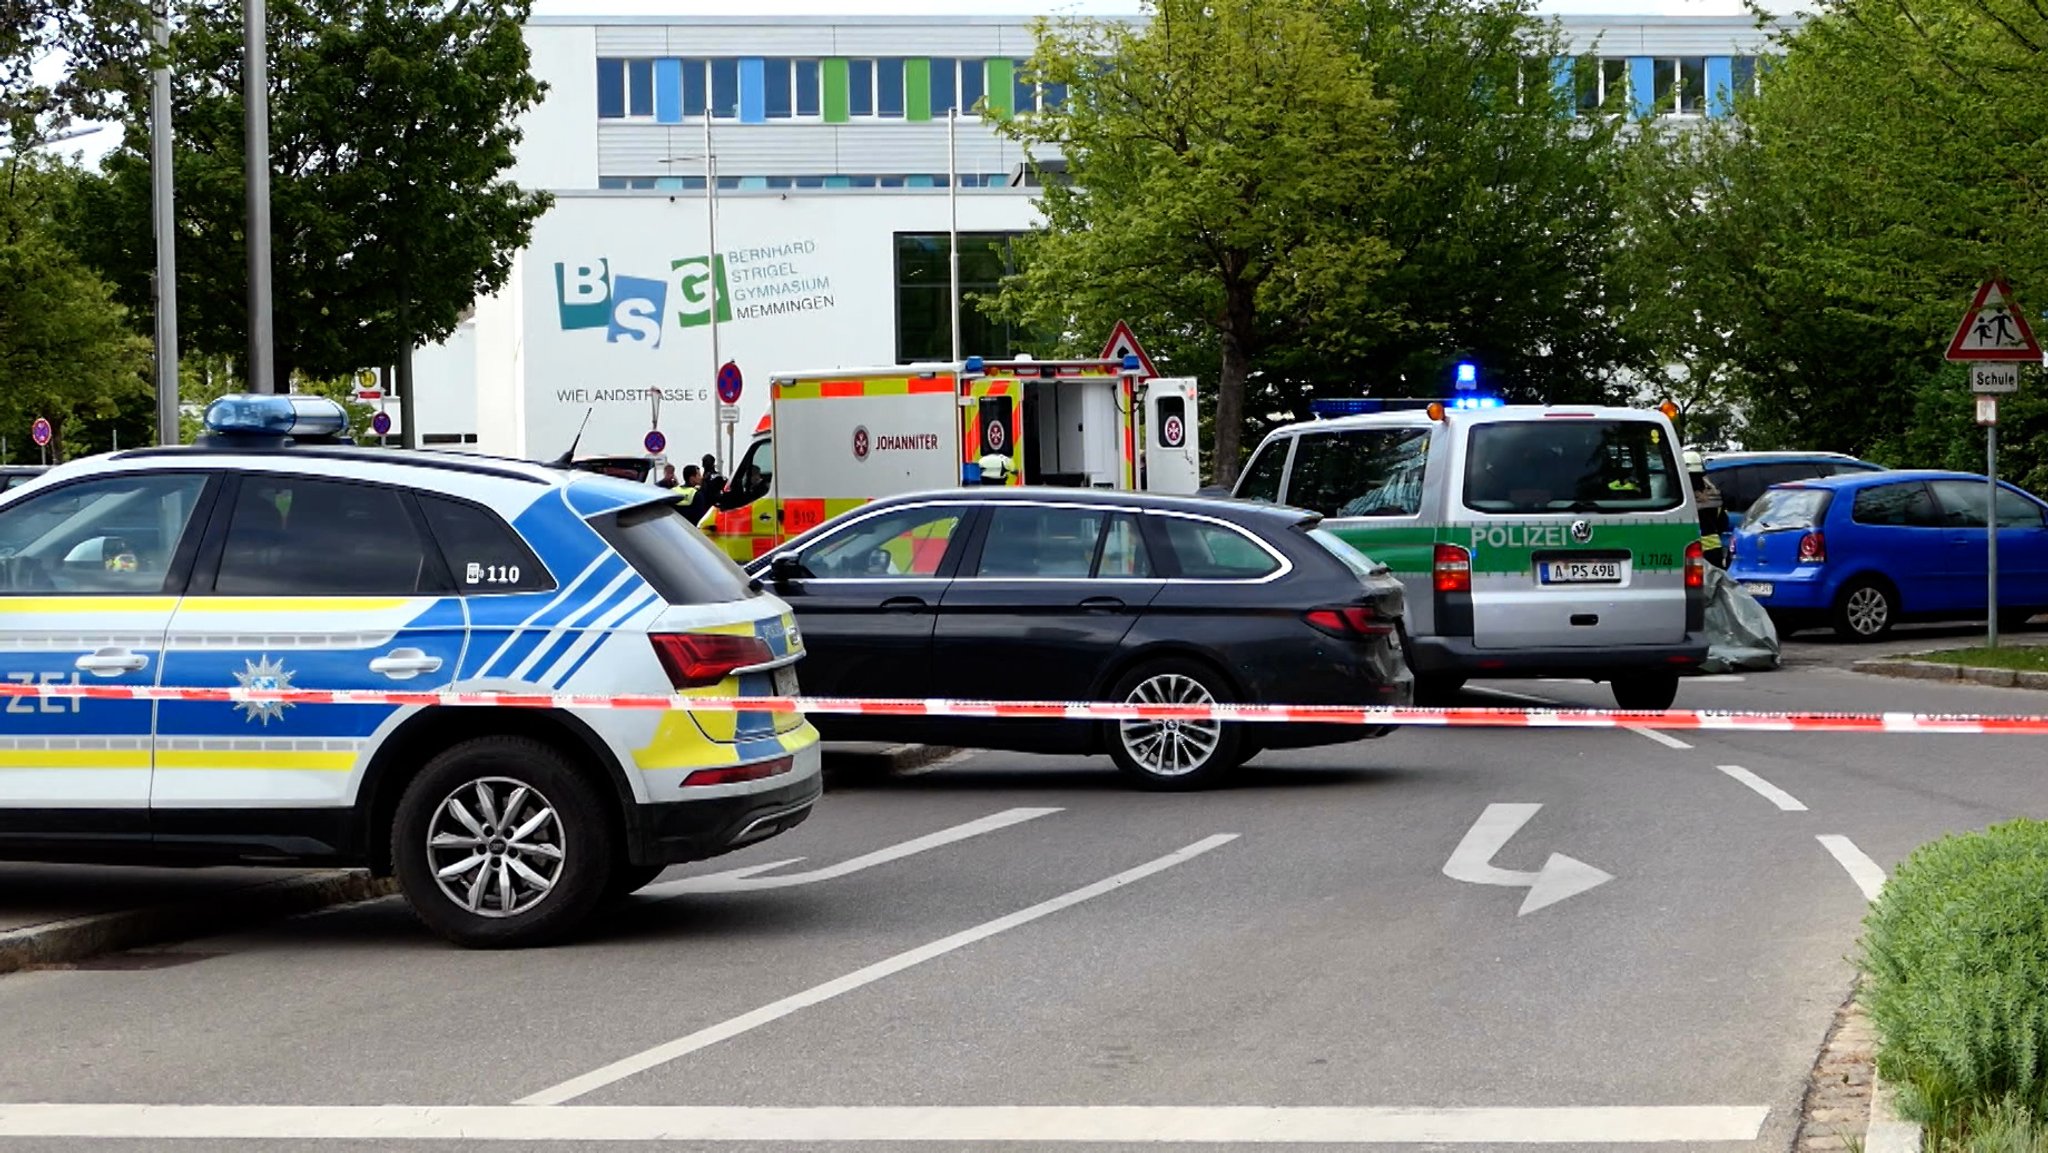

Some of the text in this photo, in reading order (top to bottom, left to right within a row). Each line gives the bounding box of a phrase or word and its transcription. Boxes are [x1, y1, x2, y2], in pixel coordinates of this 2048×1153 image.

[729, 240, 816, 263] BERNHARD
[731, 262, 798, 284] STRIGEL
[734, 277, 831, 302] GYMNASIUM
[737, 296, 836, 321] MEMMINGEN
[1976, 371, 2015, 386] Schule
[699, 388, 708, 402] 6
[875, 433, 938, 450] JOHANNITER
[1471, 526, 1567, 548] POLIZEI
[487, 565, 520, 584] 110
[1554, 564, 1563, 579] A
[1571, 564, 1588, 579] PS
